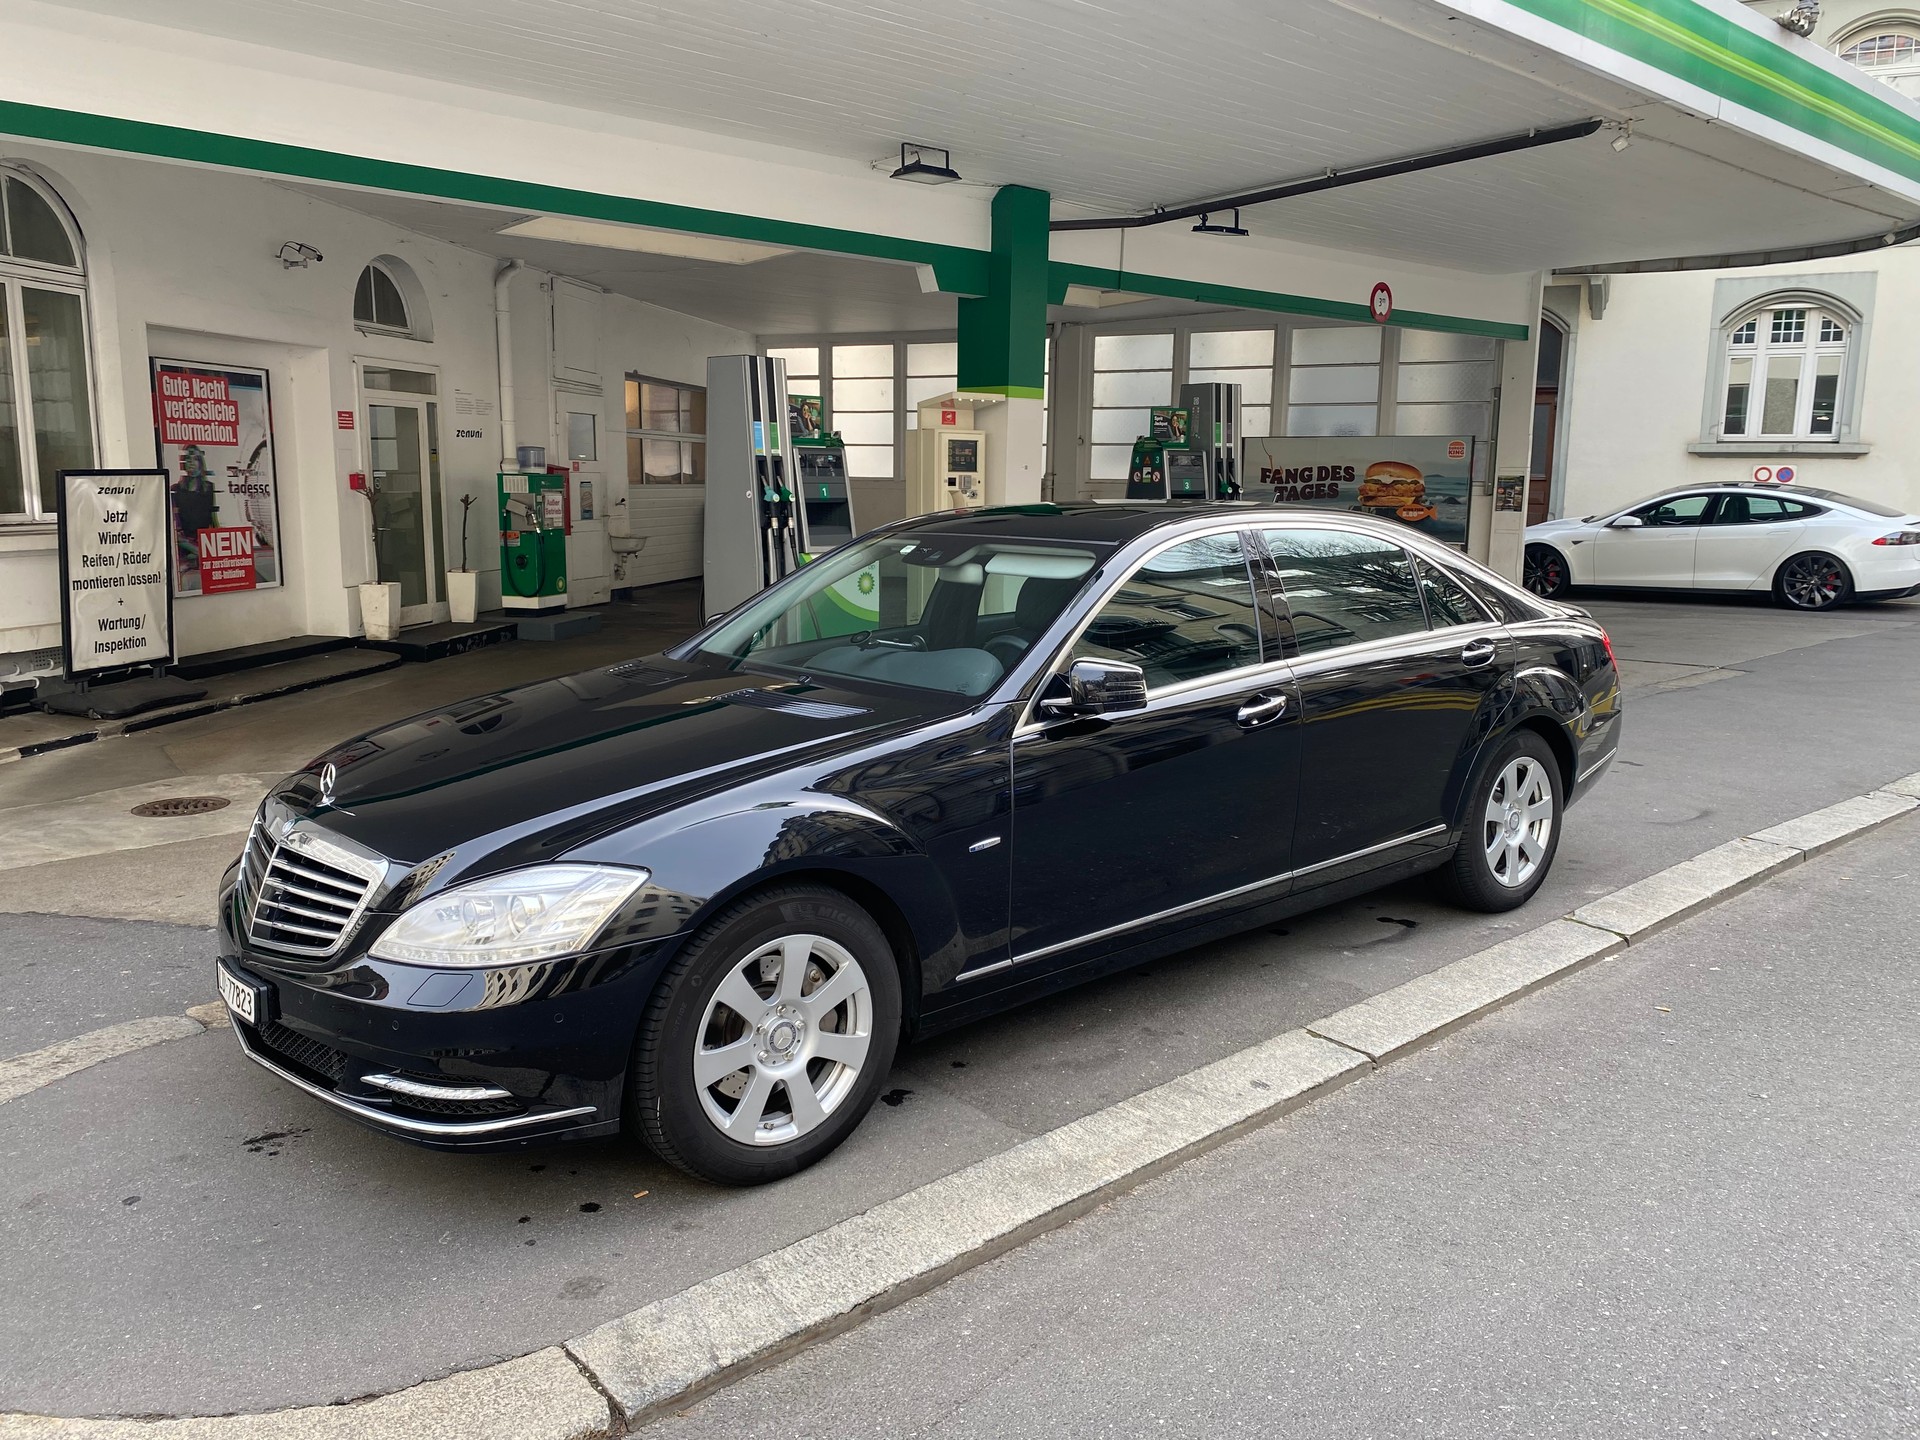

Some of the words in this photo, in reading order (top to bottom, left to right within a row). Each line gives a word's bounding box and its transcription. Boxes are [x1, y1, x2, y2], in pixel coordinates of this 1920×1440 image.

[162, 375, 190, 398] Gute
[192, 378, 226, 400] Nacht
[164, 398, 236, 422] verlässliche
[166, 420, 237, 443] Information.
[456, 428, 483, 438] zenuni
[1155, 456, 1160, 464] 3
[1260, 467, 1313, 484] FANG
[1316, 465, 1355, 482] DES
[97, 485, 136, 495] zenuni
[821, 487, 827, 497] 1
[1184, 481, 1190, 490] 3
[1274, 482, 1339, 503] TAGES
[103, 510, 128, 523] Jetzt
[98, 531, 135, 545] Winter-
[200, 531, 252, 558] NEIN
[82, 554, 115, 568] Reifen
[122, 551, 151, 565] Räder
[72, 575, 125, 591] montieren
[127, 571, 161, 586] lassen!
[94, 636, 147, 654] Inspektion
